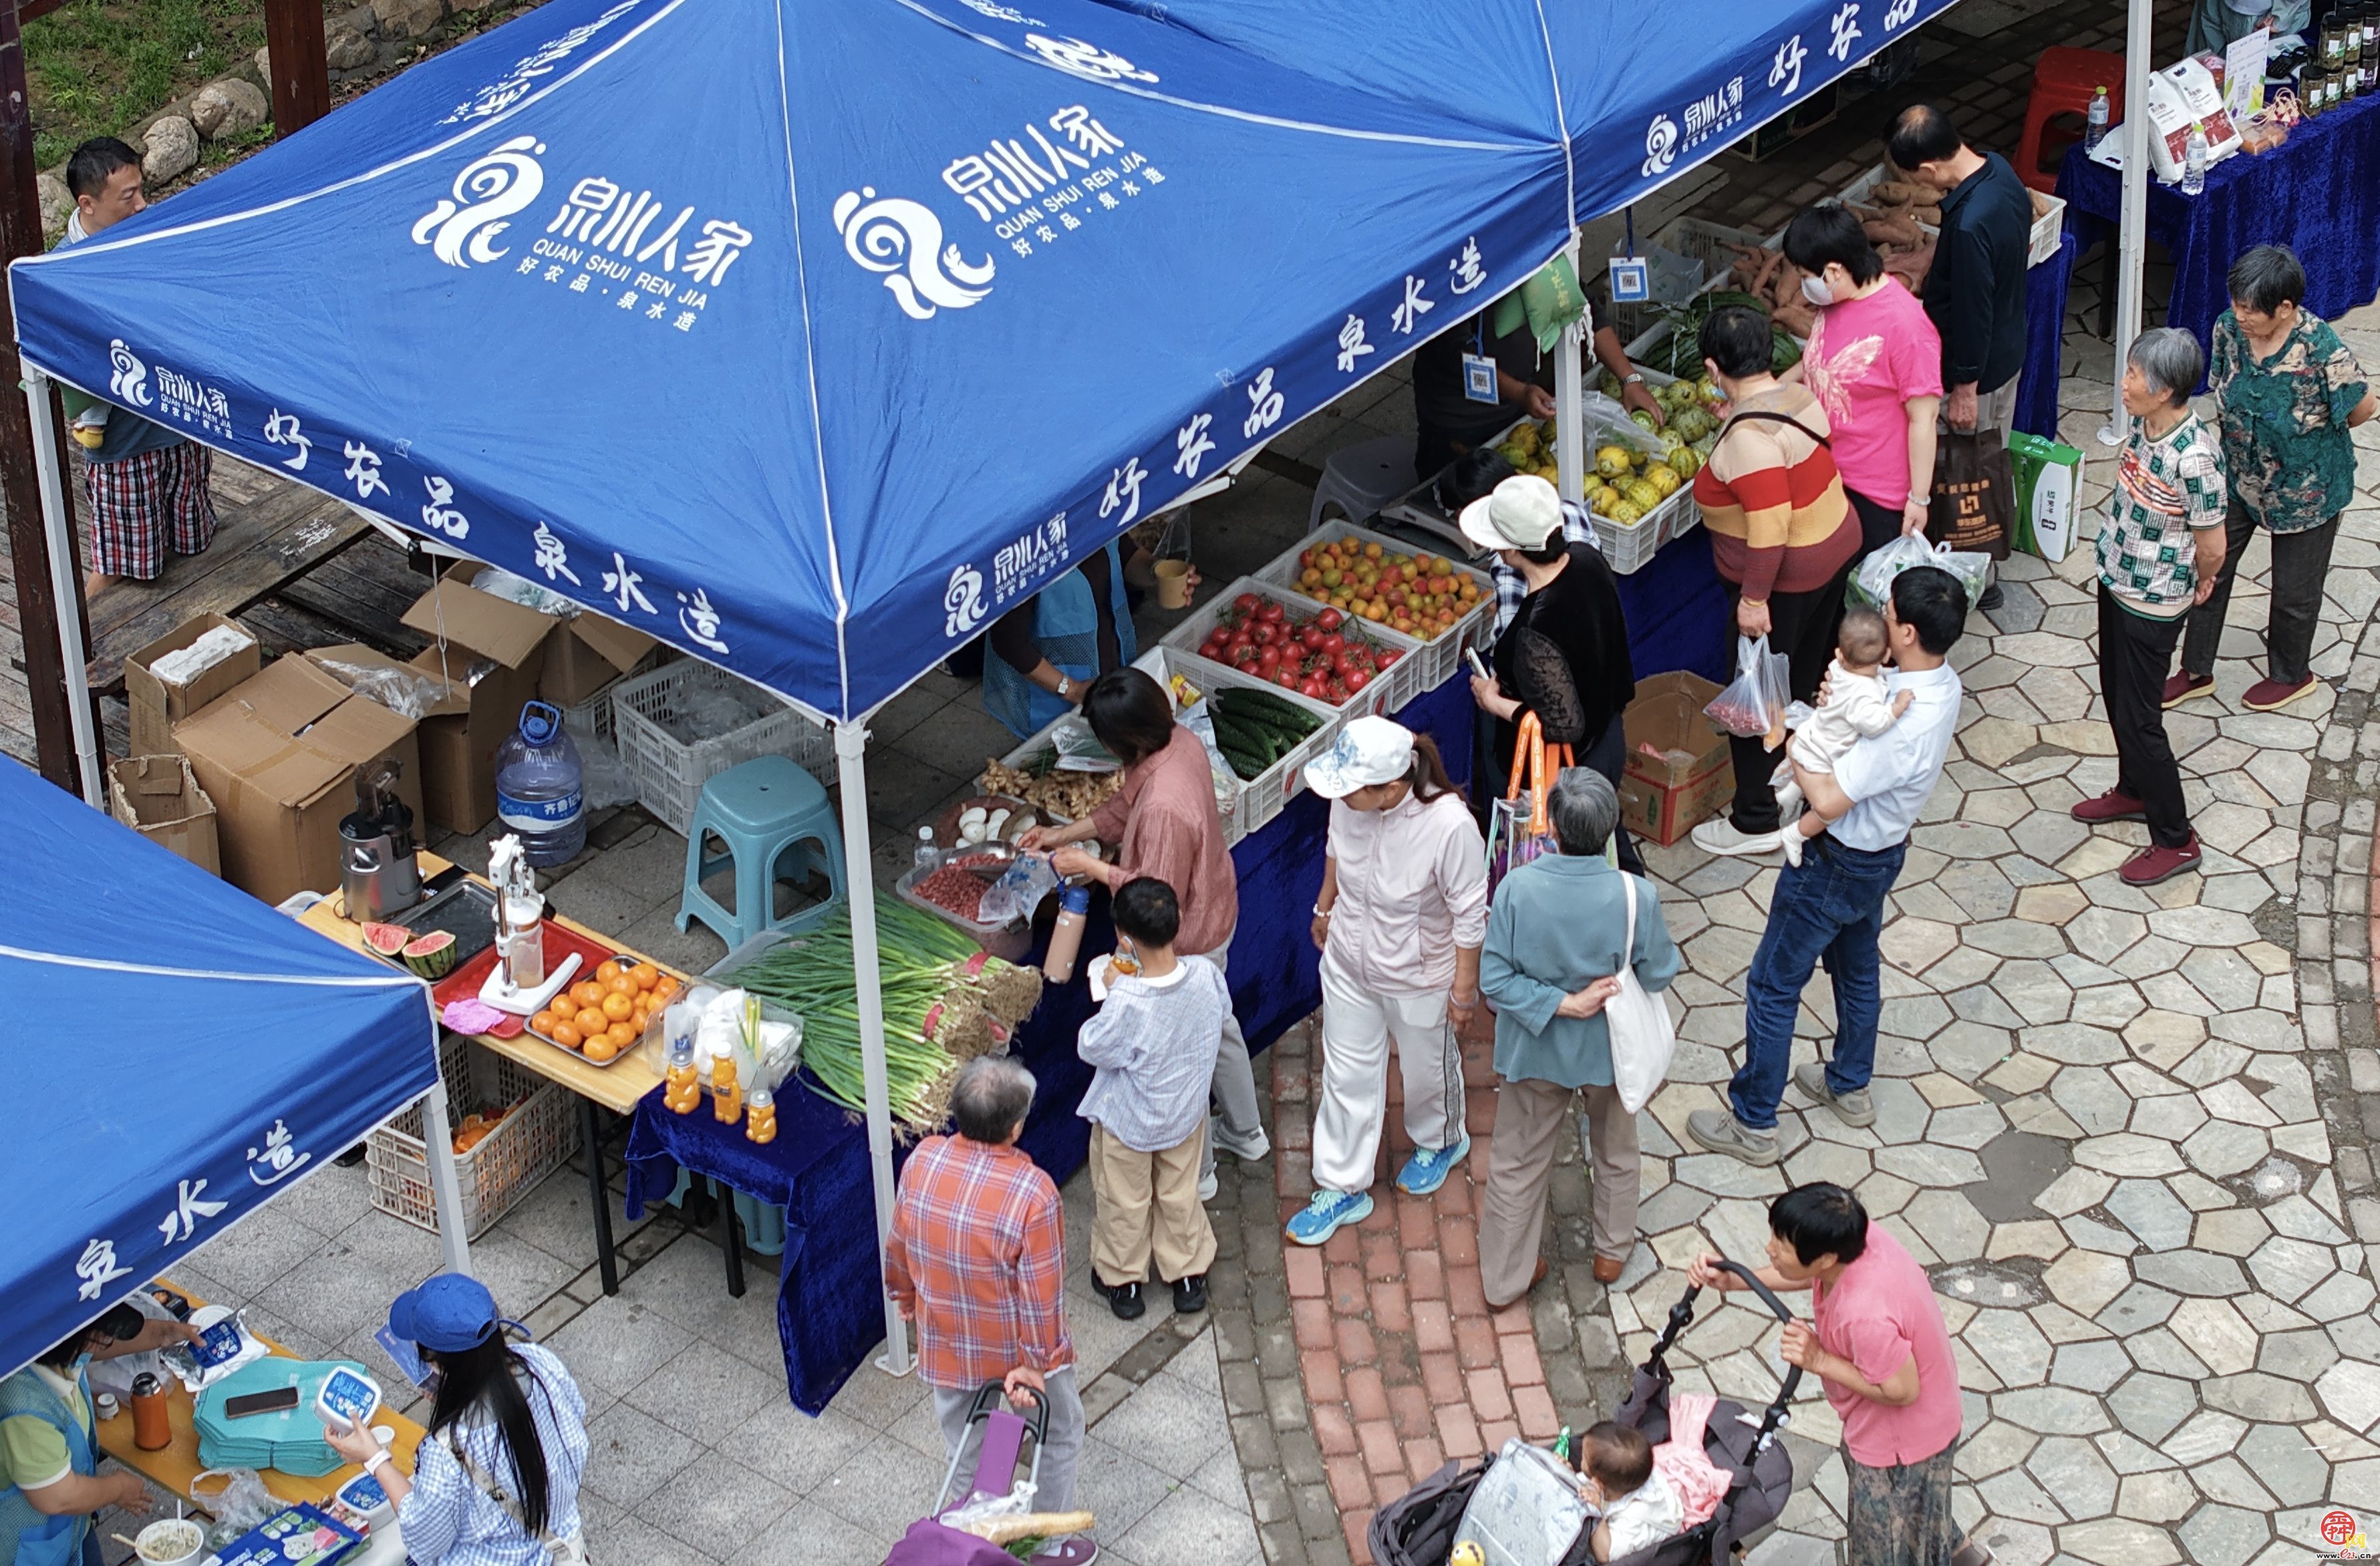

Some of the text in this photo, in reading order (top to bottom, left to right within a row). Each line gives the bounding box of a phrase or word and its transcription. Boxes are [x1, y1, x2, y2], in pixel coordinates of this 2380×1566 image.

[1685, 77, 1742, 136] 泉水人家
[942, 106, 1124, 222] 泉水人家
[996, 152, 1148, 239] QUAN SHUI REN JIA
[547, 177, 752, 287] 泉水人家
[533, 239, 707, 310] QUAN SHUI REN JIA
[156, 366, 229, 418] 泉水人家
[161, 395, 231, 429] QUAN SHUI REN JIA
[994, 512, 1066, 585] 泉水人家
[996, 577, 1016, 593] QUAN
[1020, 563, 1036, 577] SHUI
[1038, 551, 1054, 565] REN
[76, 1120, 311, 1299] 泉水造
